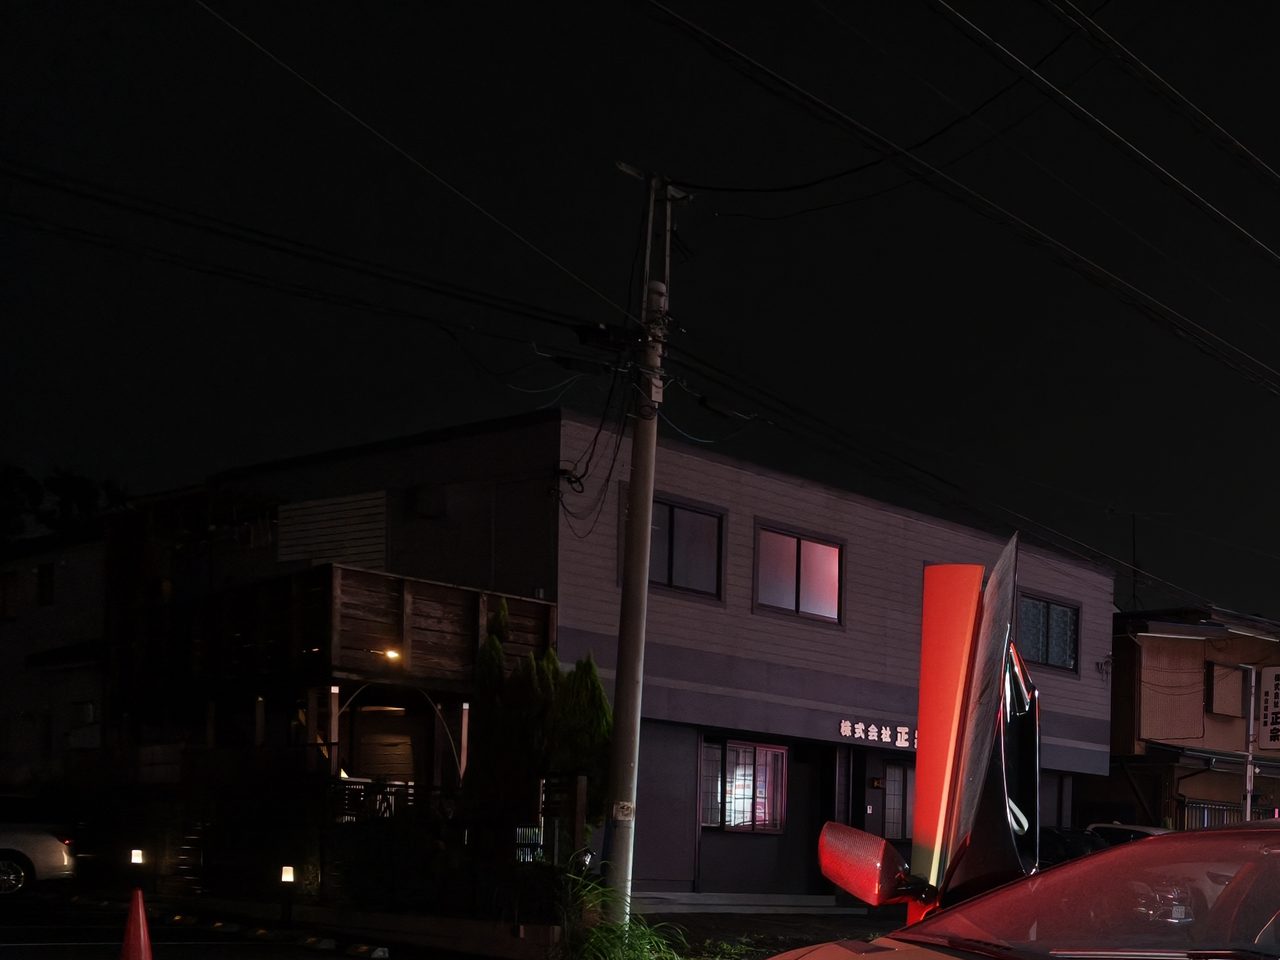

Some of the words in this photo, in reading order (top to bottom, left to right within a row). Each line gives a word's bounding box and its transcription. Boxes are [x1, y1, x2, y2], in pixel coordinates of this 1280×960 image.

[840, 719, 918, 749] 株式会社正
